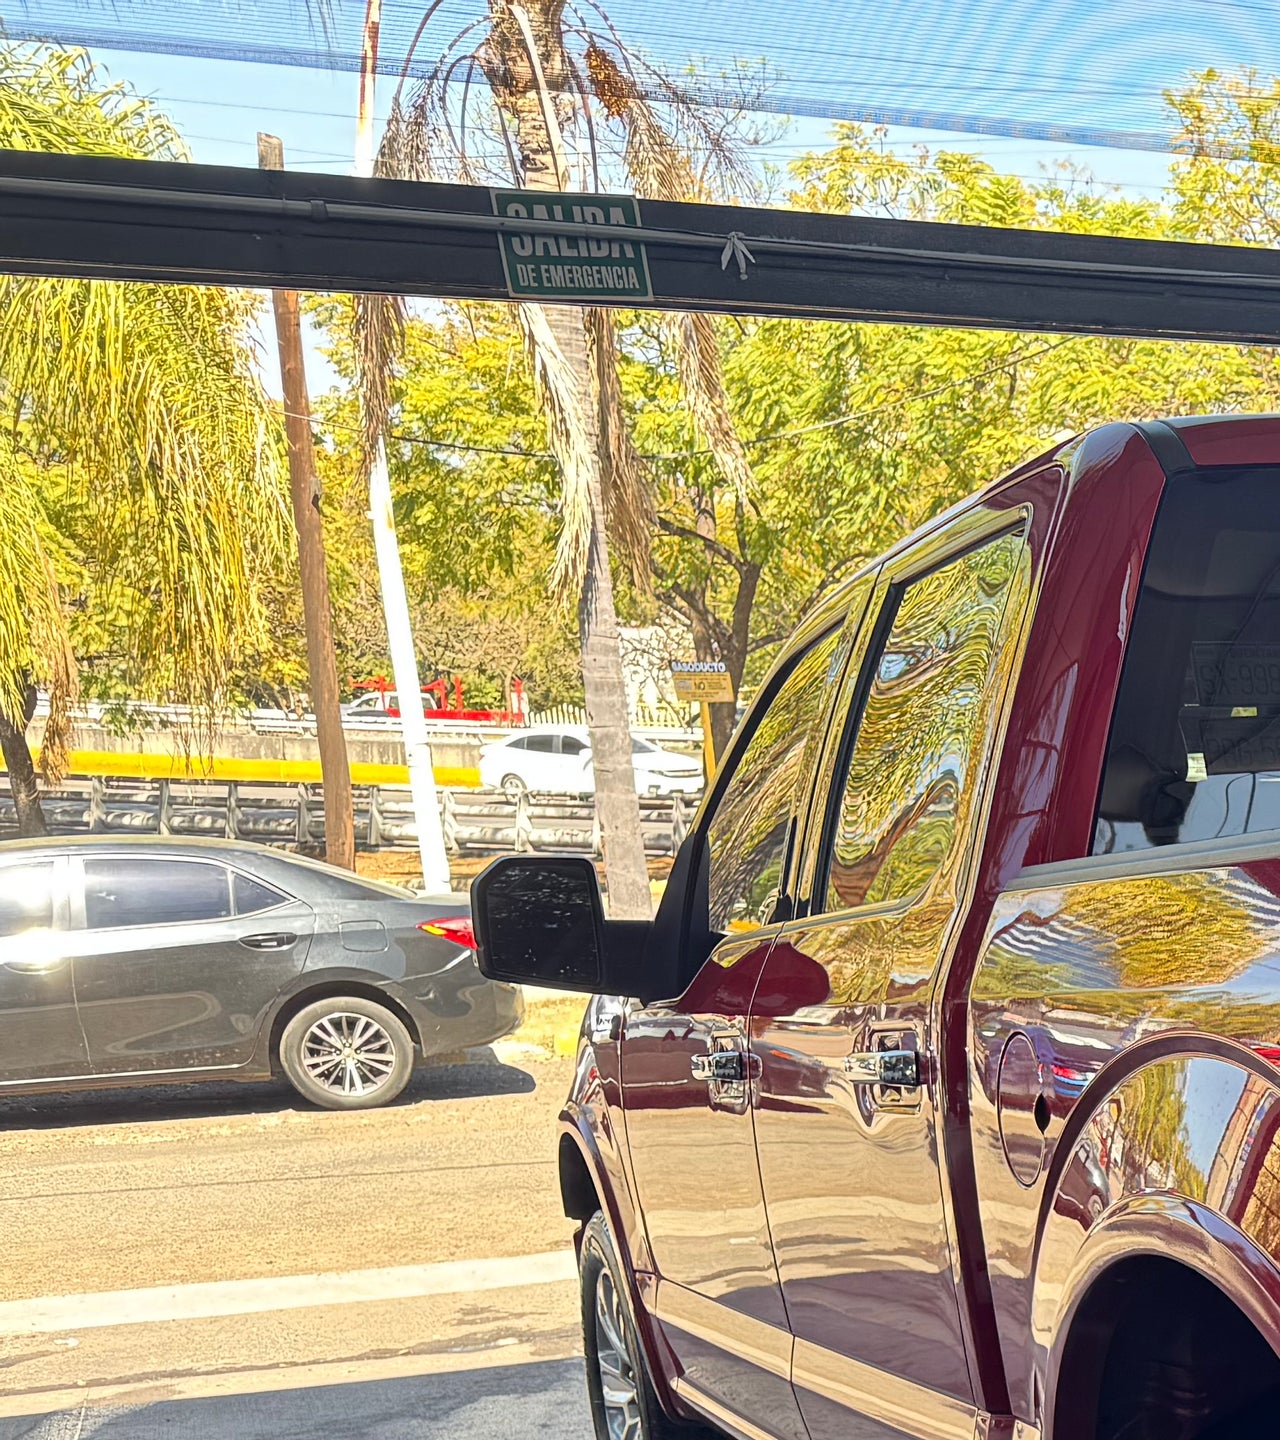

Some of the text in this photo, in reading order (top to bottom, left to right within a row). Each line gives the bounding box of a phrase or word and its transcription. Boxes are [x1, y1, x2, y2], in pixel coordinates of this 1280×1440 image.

[507, 203, 635, 258] SALIDA
[516, 264, 640, 289] DE EMERGENCIA
